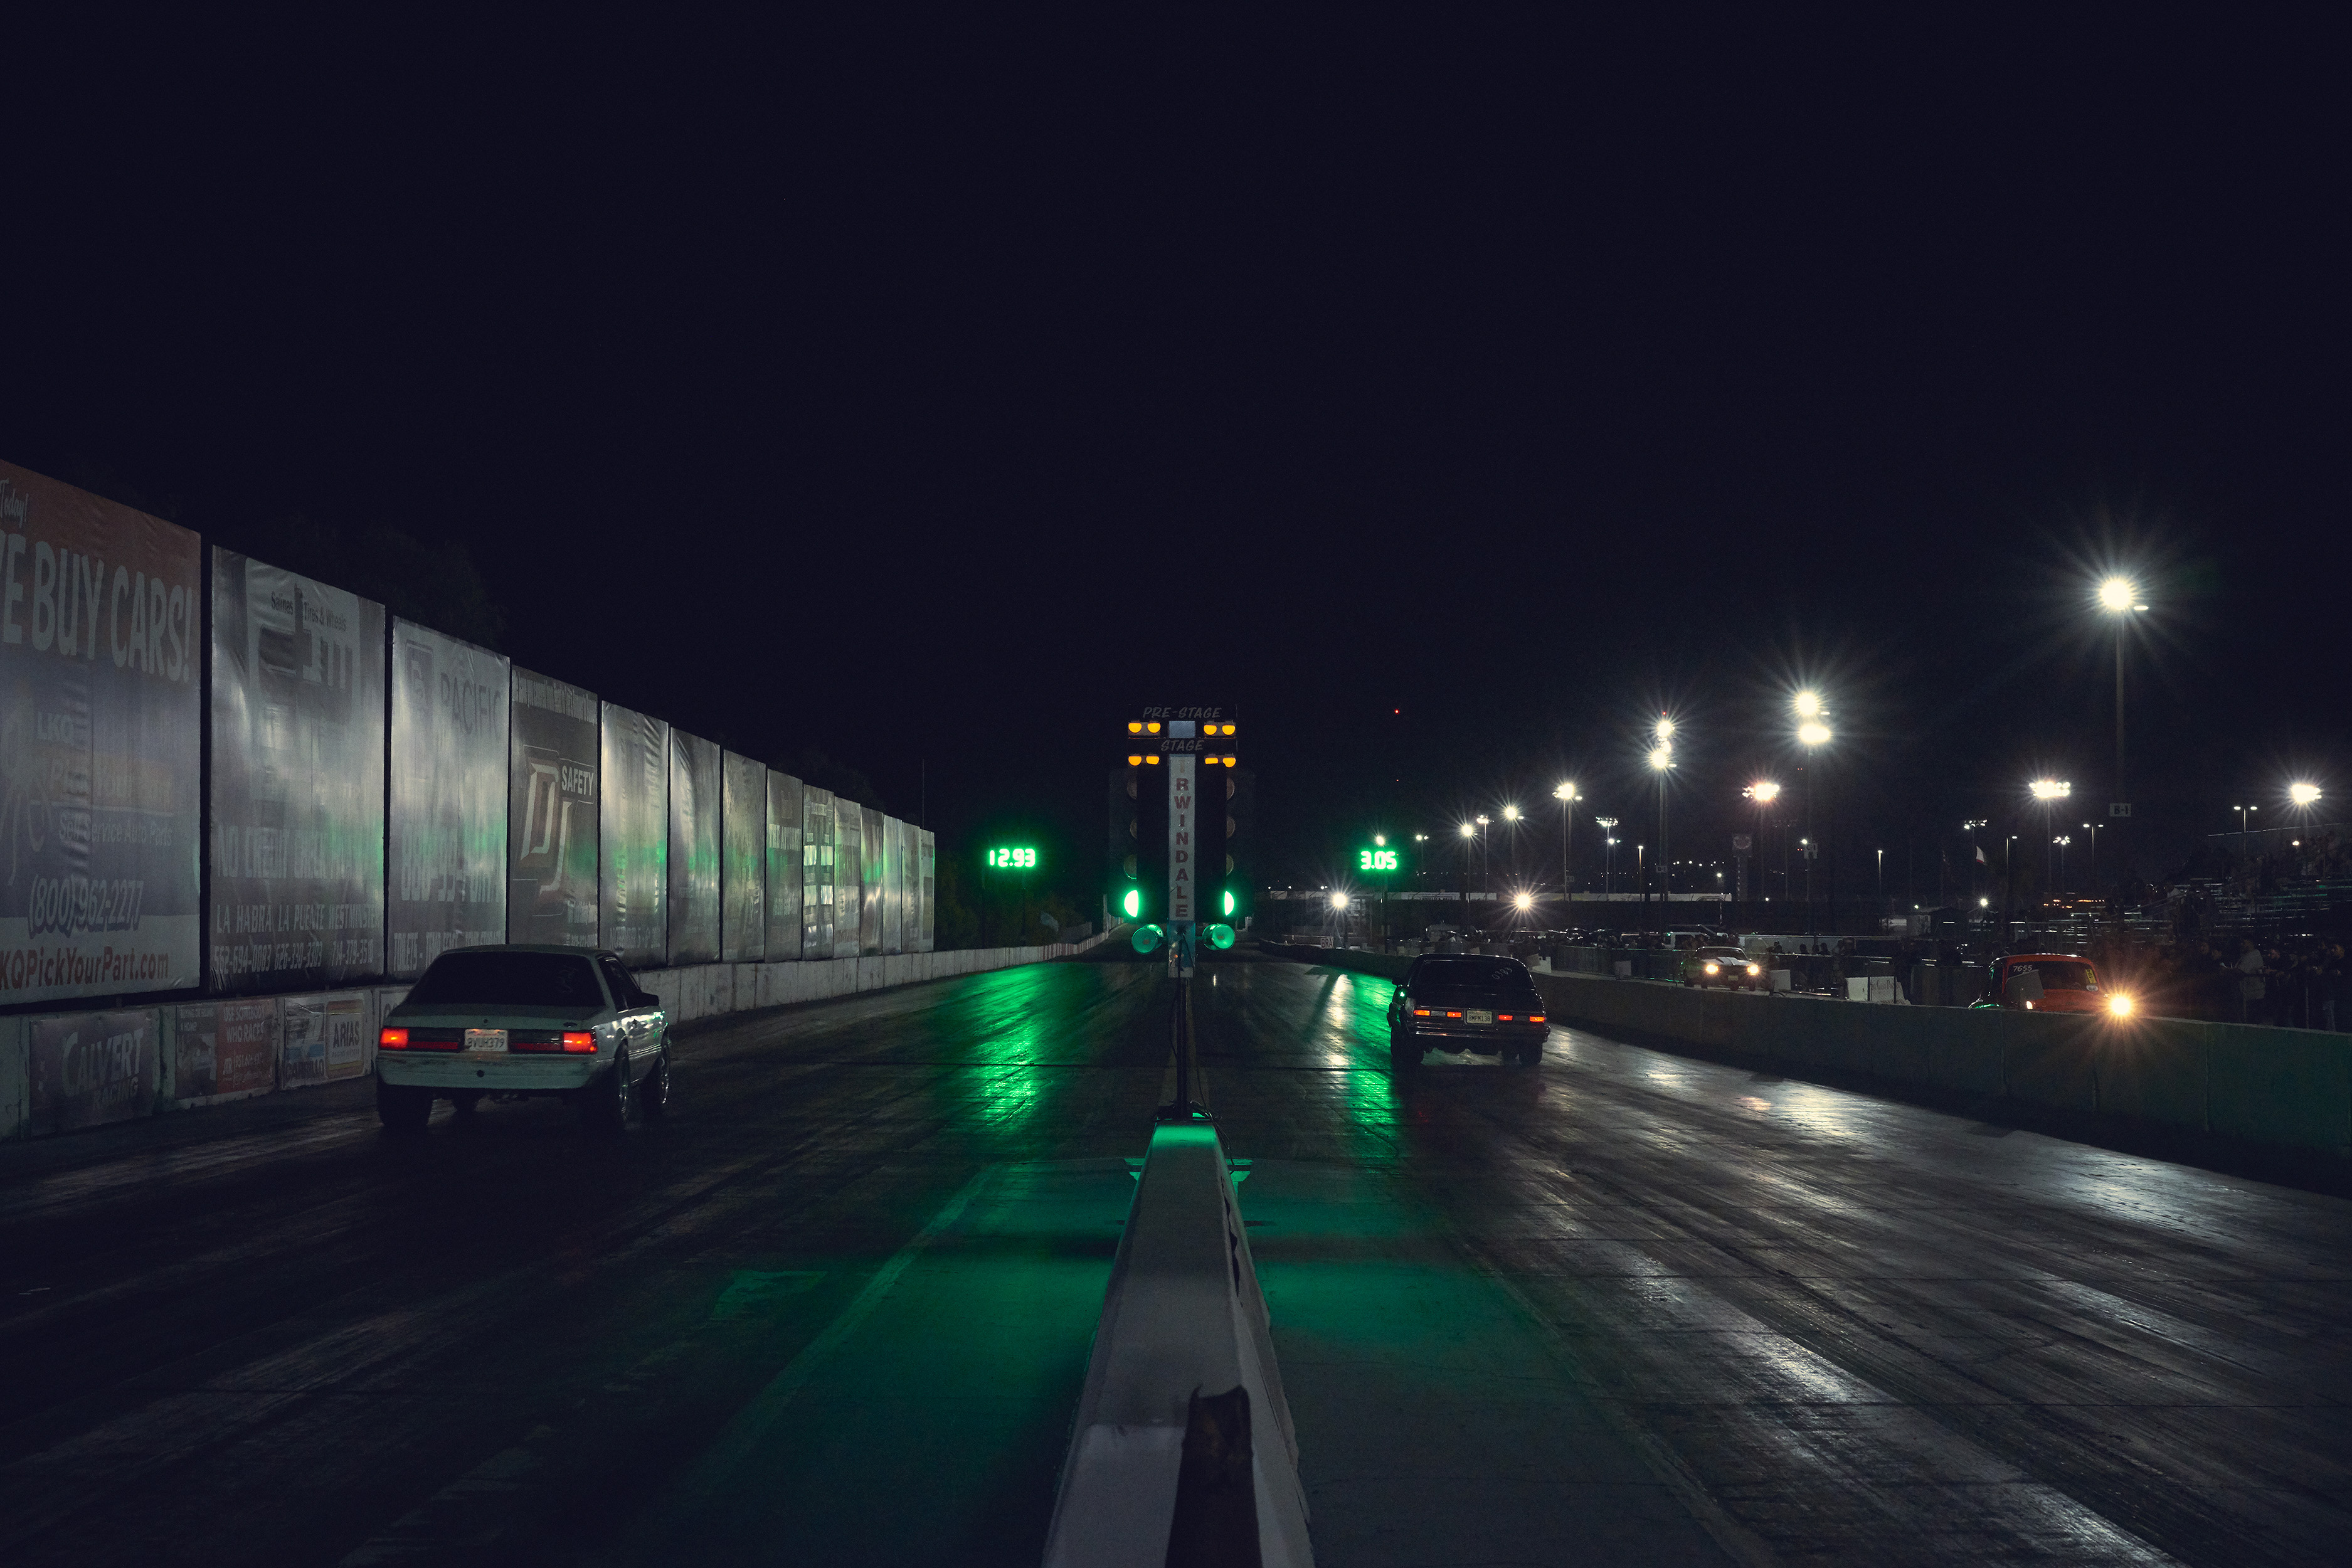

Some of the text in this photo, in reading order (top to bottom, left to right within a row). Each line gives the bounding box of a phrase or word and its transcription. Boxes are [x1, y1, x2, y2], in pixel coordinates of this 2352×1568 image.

[32, 541, 104, 660] BUY
[110, 564, 193, 683] CARS!
[304, 601, 318, 623] Tires
[1143, 707, 1222, 718] PRE-STAGE
[1160, 739, 1204, 751] STAGE
[561, 765, 594, 796] SAFETY
[989, 848, 1036, 867] 12.93
[1360, 850, 1397, 870] 3.05
[216, 904, 230, 933] LA
[236, 904, 272, 933] HABRA
[278, 904, 289, 931] LA
[294, 904, 325, 930] PUENTE
[2013, 965, 2033, 973] 7655
[226, 1025, 243, 1043] WHO
[333, 1020, 360, 1048] ARIAS
[61, 1027, 144, 1098] CALVERT
[93, 1076, 139, 1110] RACING
